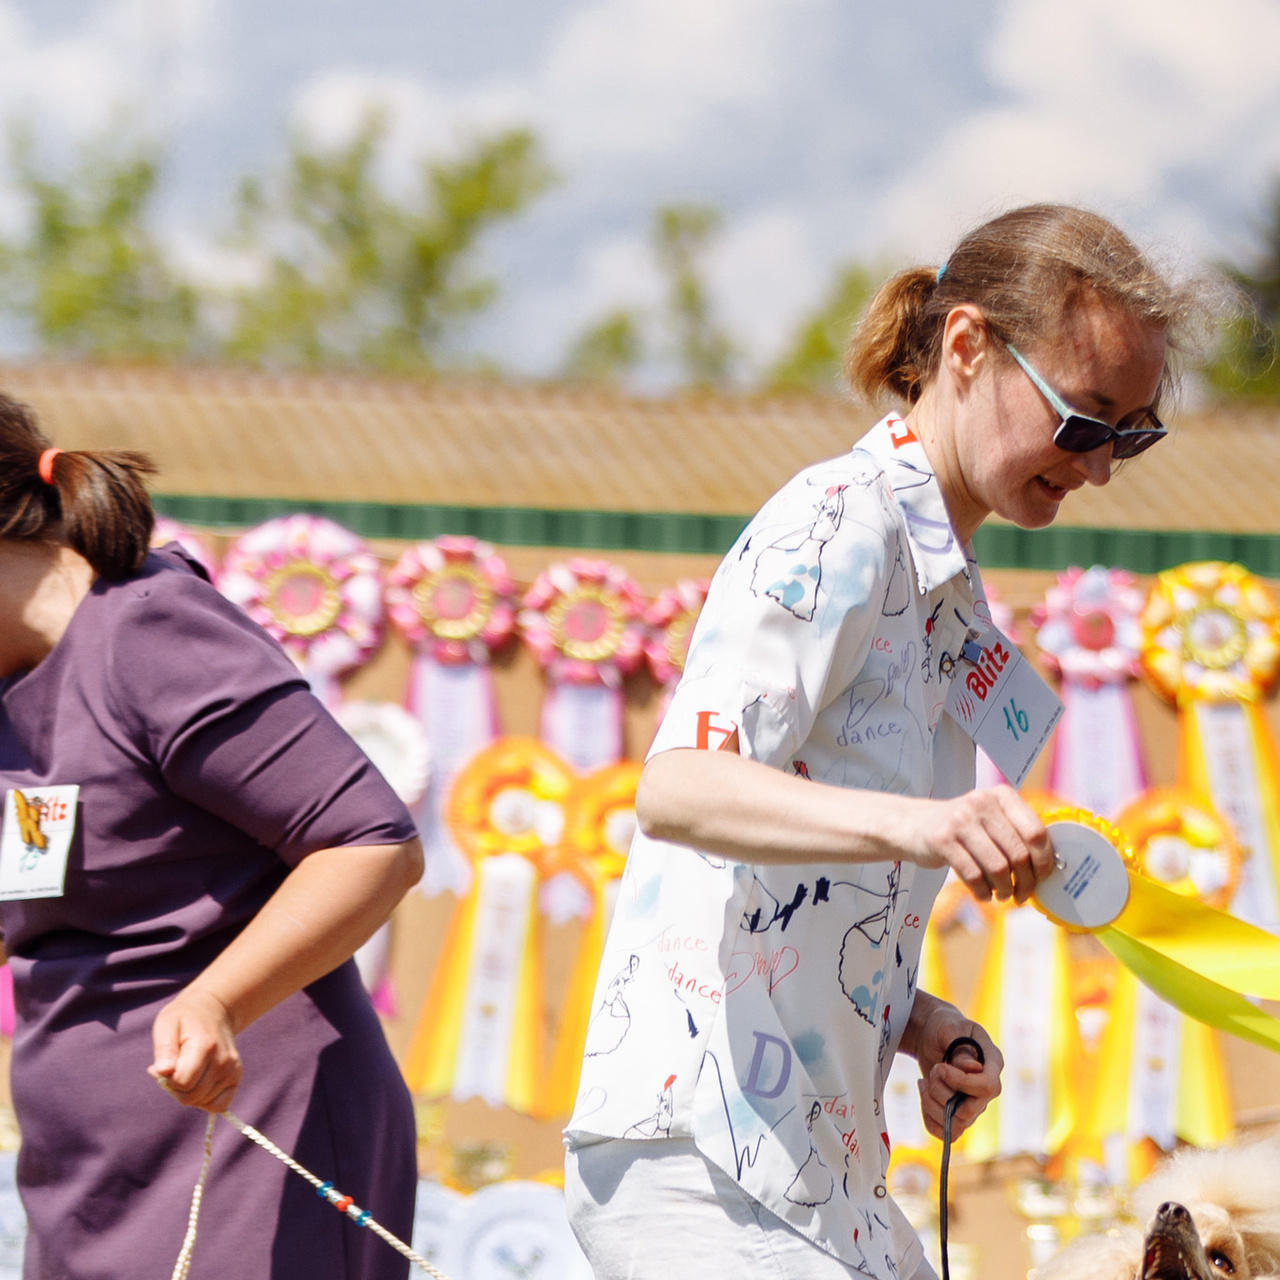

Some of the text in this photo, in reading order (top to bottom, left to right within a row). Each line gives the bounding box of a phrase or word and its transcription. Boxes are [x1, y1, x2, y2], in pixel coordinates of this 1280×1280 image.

[965, 641, 1010, 702] Blitz
[836, 724, 902, 747] dance
[1003, 698, 1029, 741] 16
[657, 931, 709, 952] dance
[668, 961, 722, 1004] dance
[739, 1031, 792, 1099] D
